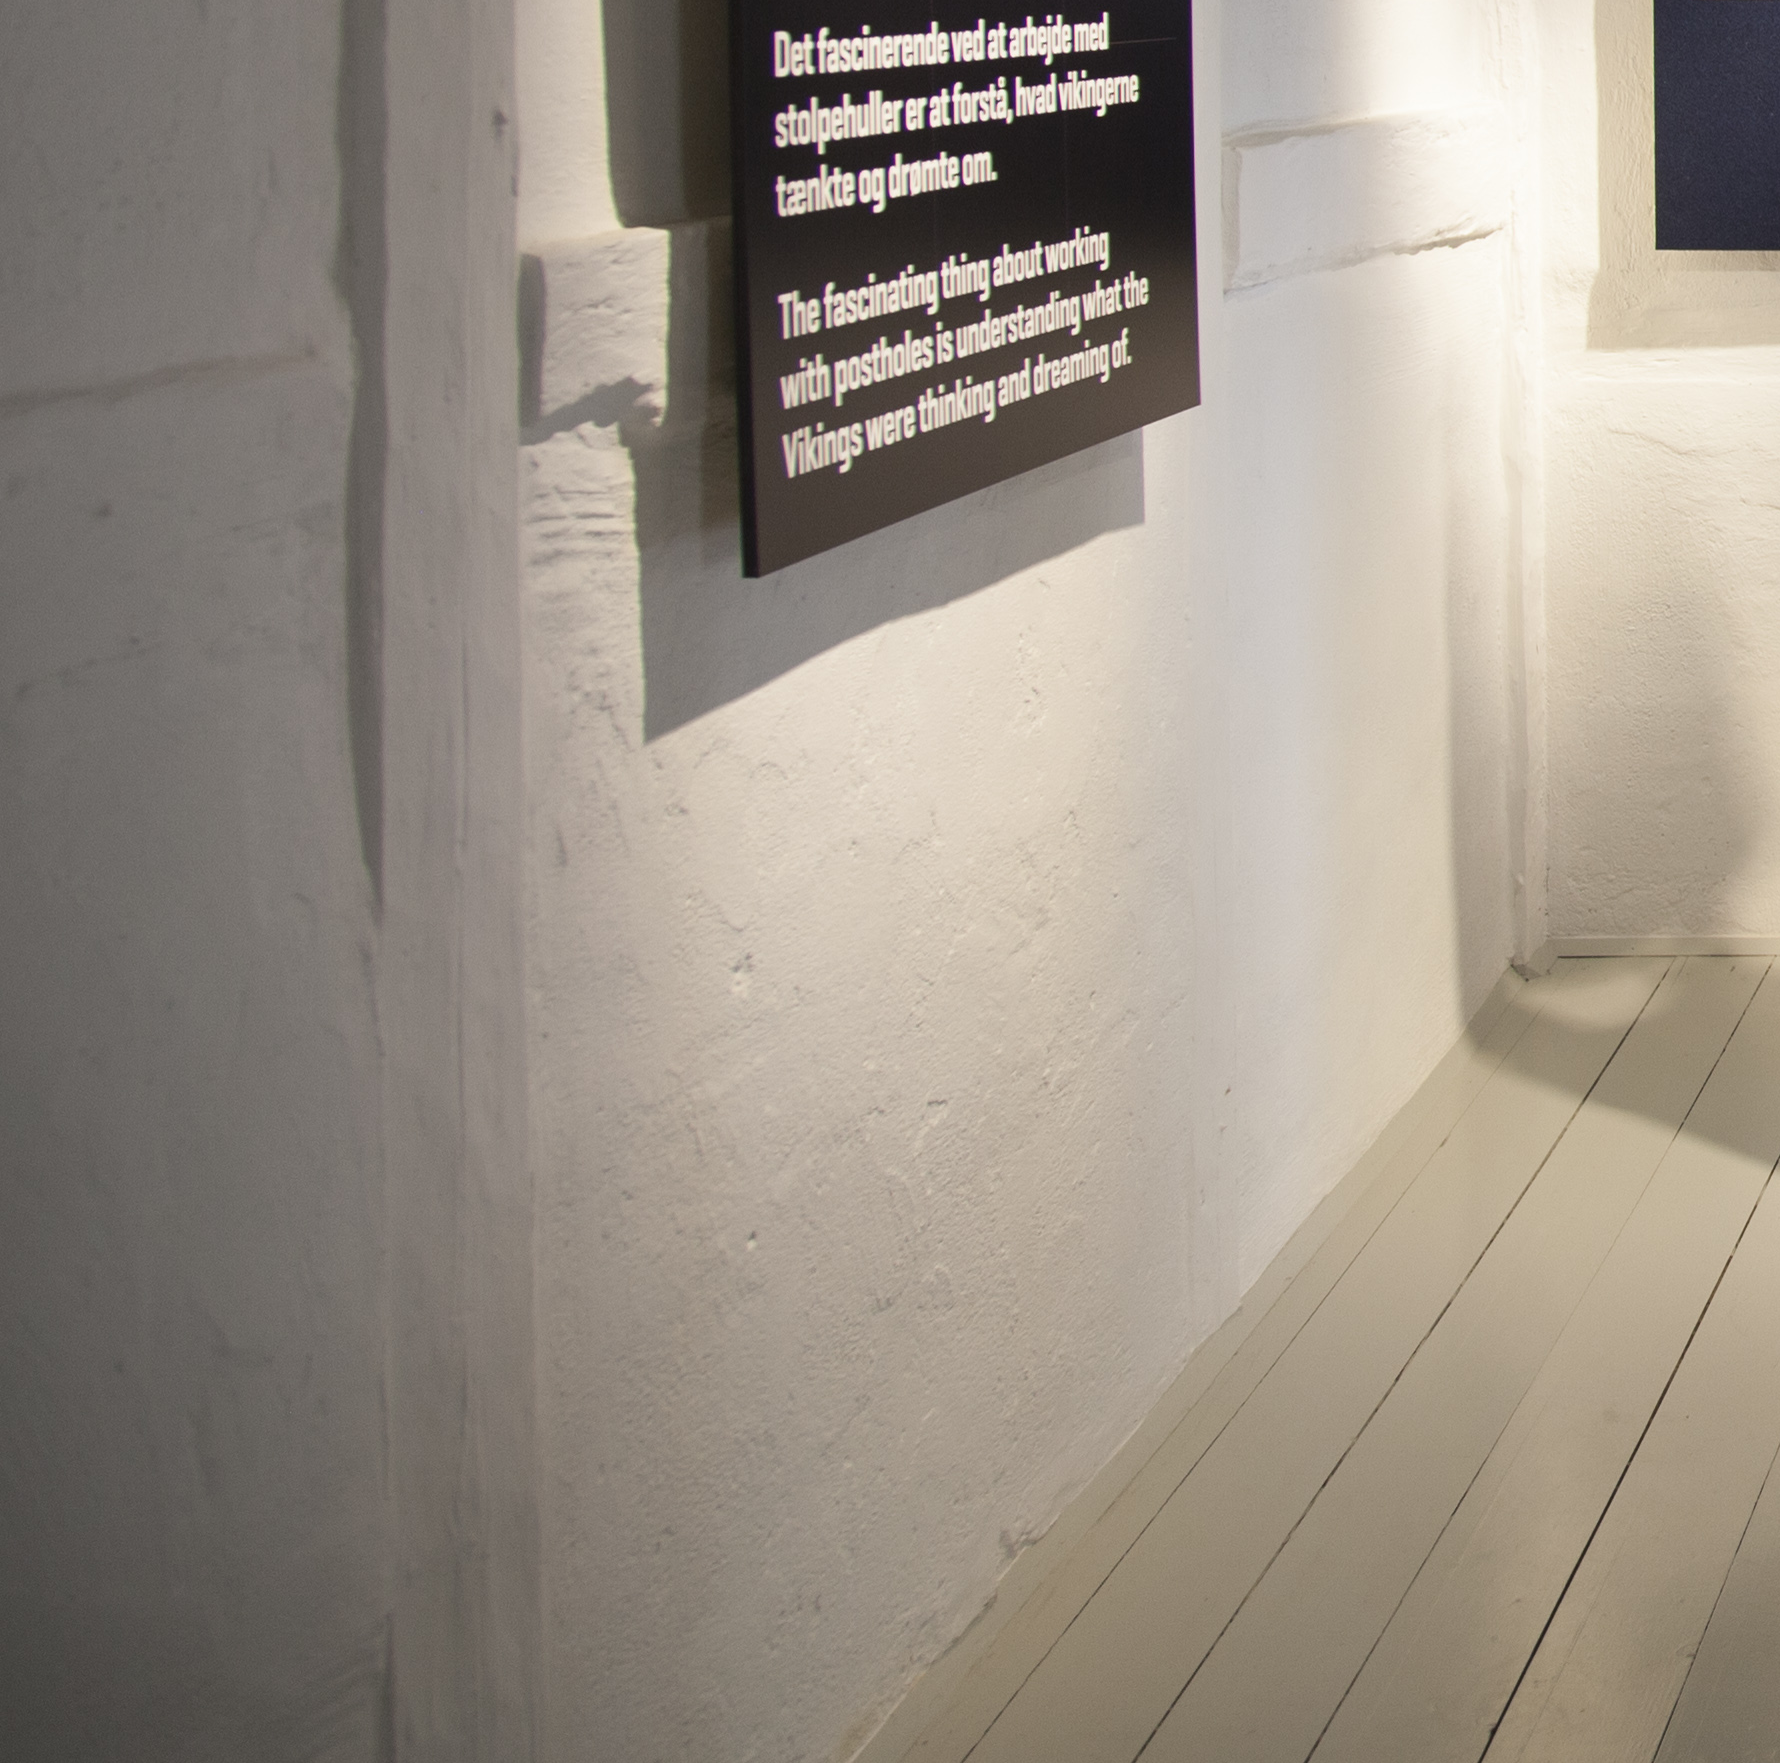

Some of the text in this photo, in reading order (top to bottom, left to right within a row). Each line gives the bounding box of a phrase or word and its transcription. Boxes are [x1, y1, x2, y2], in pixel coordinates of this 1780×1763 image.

[773, 12, 1110, 77] Det fascinerende ved at arbejde med
[775, 70, 1140, 155] stolpehuller er at forstå, hvad vikingerne
[776, 151, 998, 217] tænkte og drømte om.
[777, 225, 1110, 339] The fascinating thing about working
[780, 270, 1150, 410] with postholes is understanding what the
[782, 327, 1133, 478] Vikings were thinking and dreaming of.
